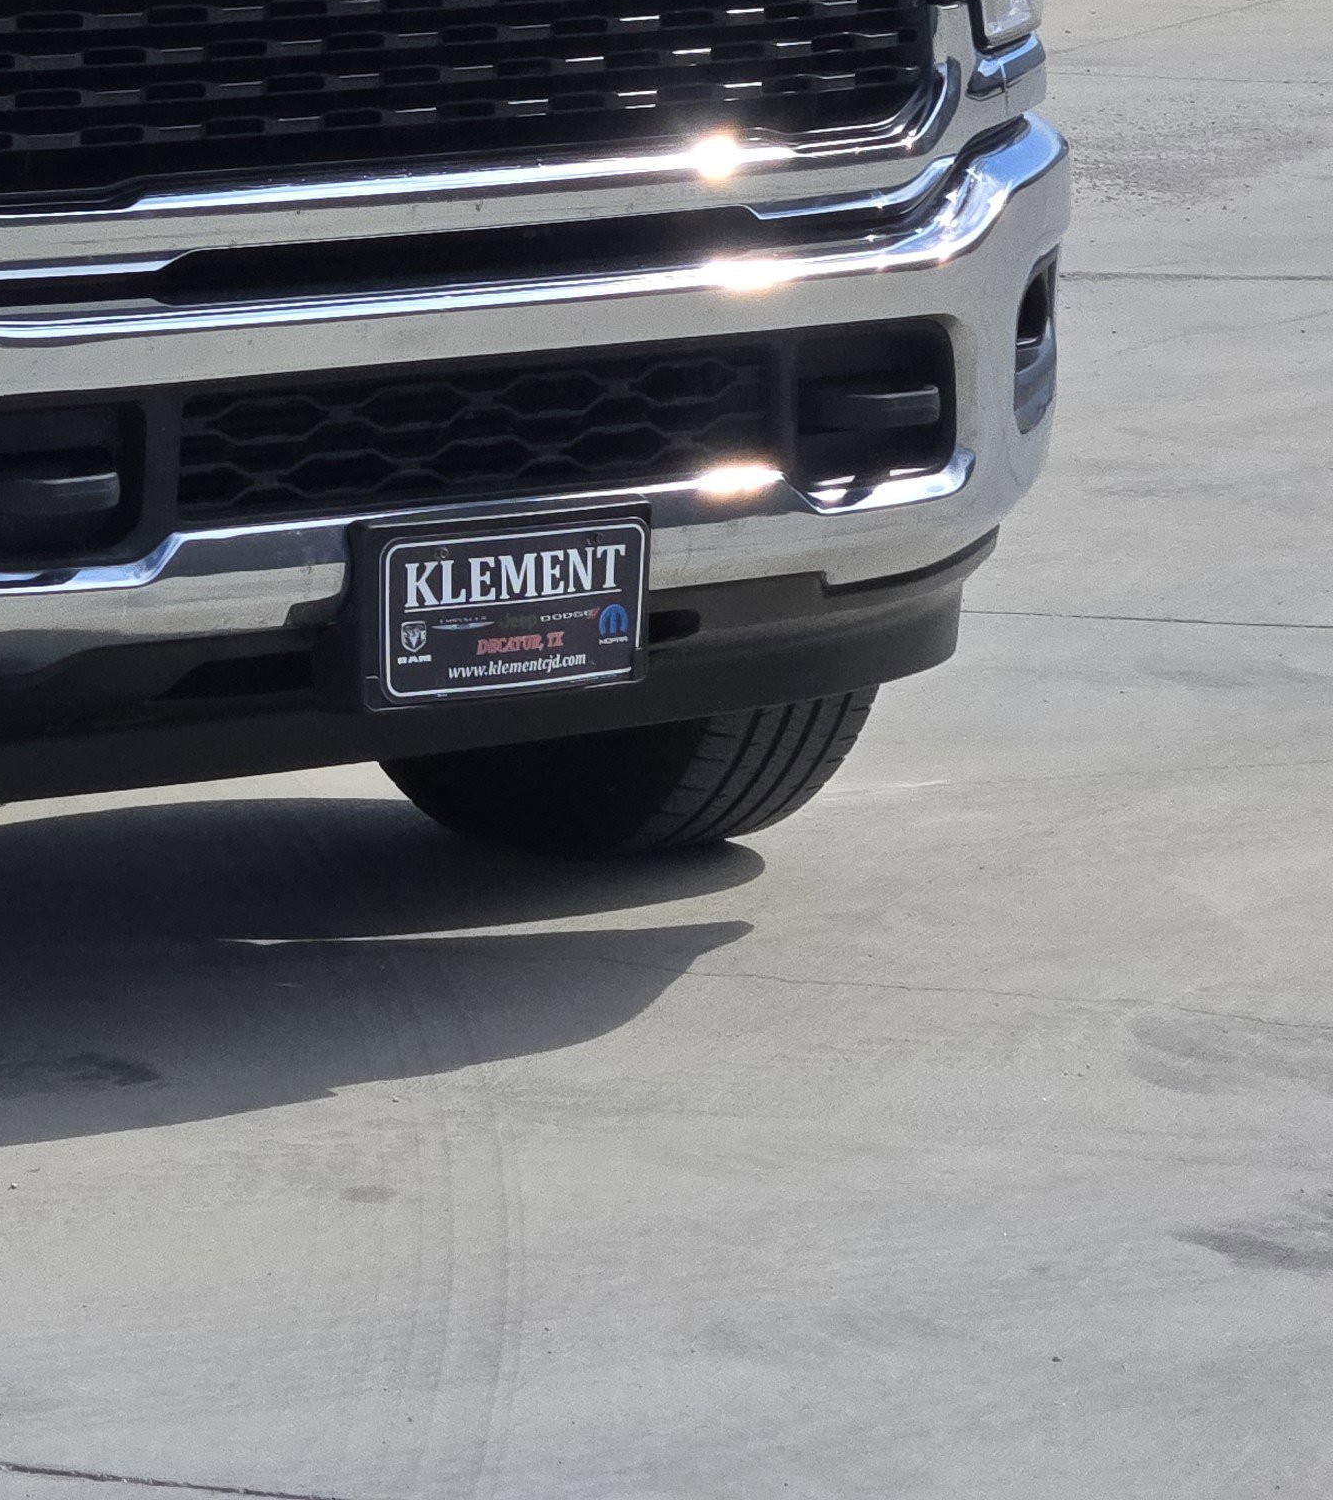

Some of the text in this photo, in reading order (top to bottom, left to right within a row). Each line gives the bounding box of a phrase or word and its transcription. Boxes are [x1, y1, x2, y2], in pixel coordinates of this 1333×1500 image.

[404, 544, 626, 608] KLEMENT
[539, 609, 593, 623] DODGE
[476, 631, 565, 656] DECATUR, TX
[396, 654, 433, 666] RAM
[447, 651, 587, 681] www.klementcjd.com
